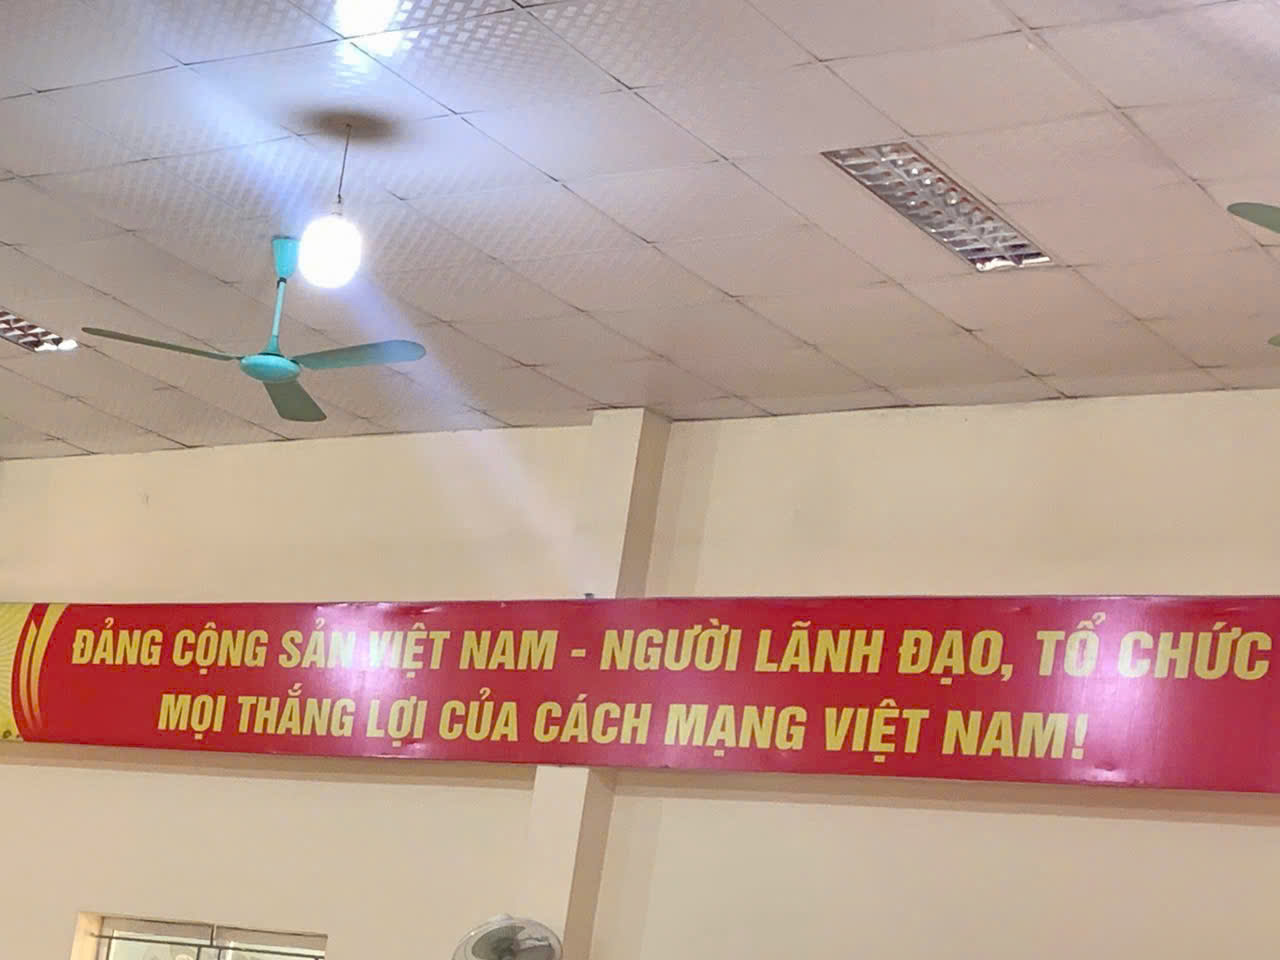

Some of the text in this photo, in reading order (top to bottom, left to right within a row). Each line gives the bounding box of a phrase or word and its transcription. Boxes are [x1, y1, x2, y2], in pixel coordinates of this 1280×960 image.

[71, 617, 163, 666] ĐẢNG
[172, 622, 269, 675] CỘNG
[278, 617, 356, 669] SẢN
[369, 622, 452, 678] VIỆT
[459, 630, 559, 670] NAM
[599, 618, 742, 672] NGƯỜI
[754, 620, 885, 673] LÃNH
[898, 629, 1014, 685] ĐẠO,
[1036, 611, 1106, 677] TỔ
[1117, 621, 1273, 681] CHỨC
[157, 682, 1088, 763] MỌI THẮNG LỢI CỦA CÁCH MẠNG VIỆT NAM!
